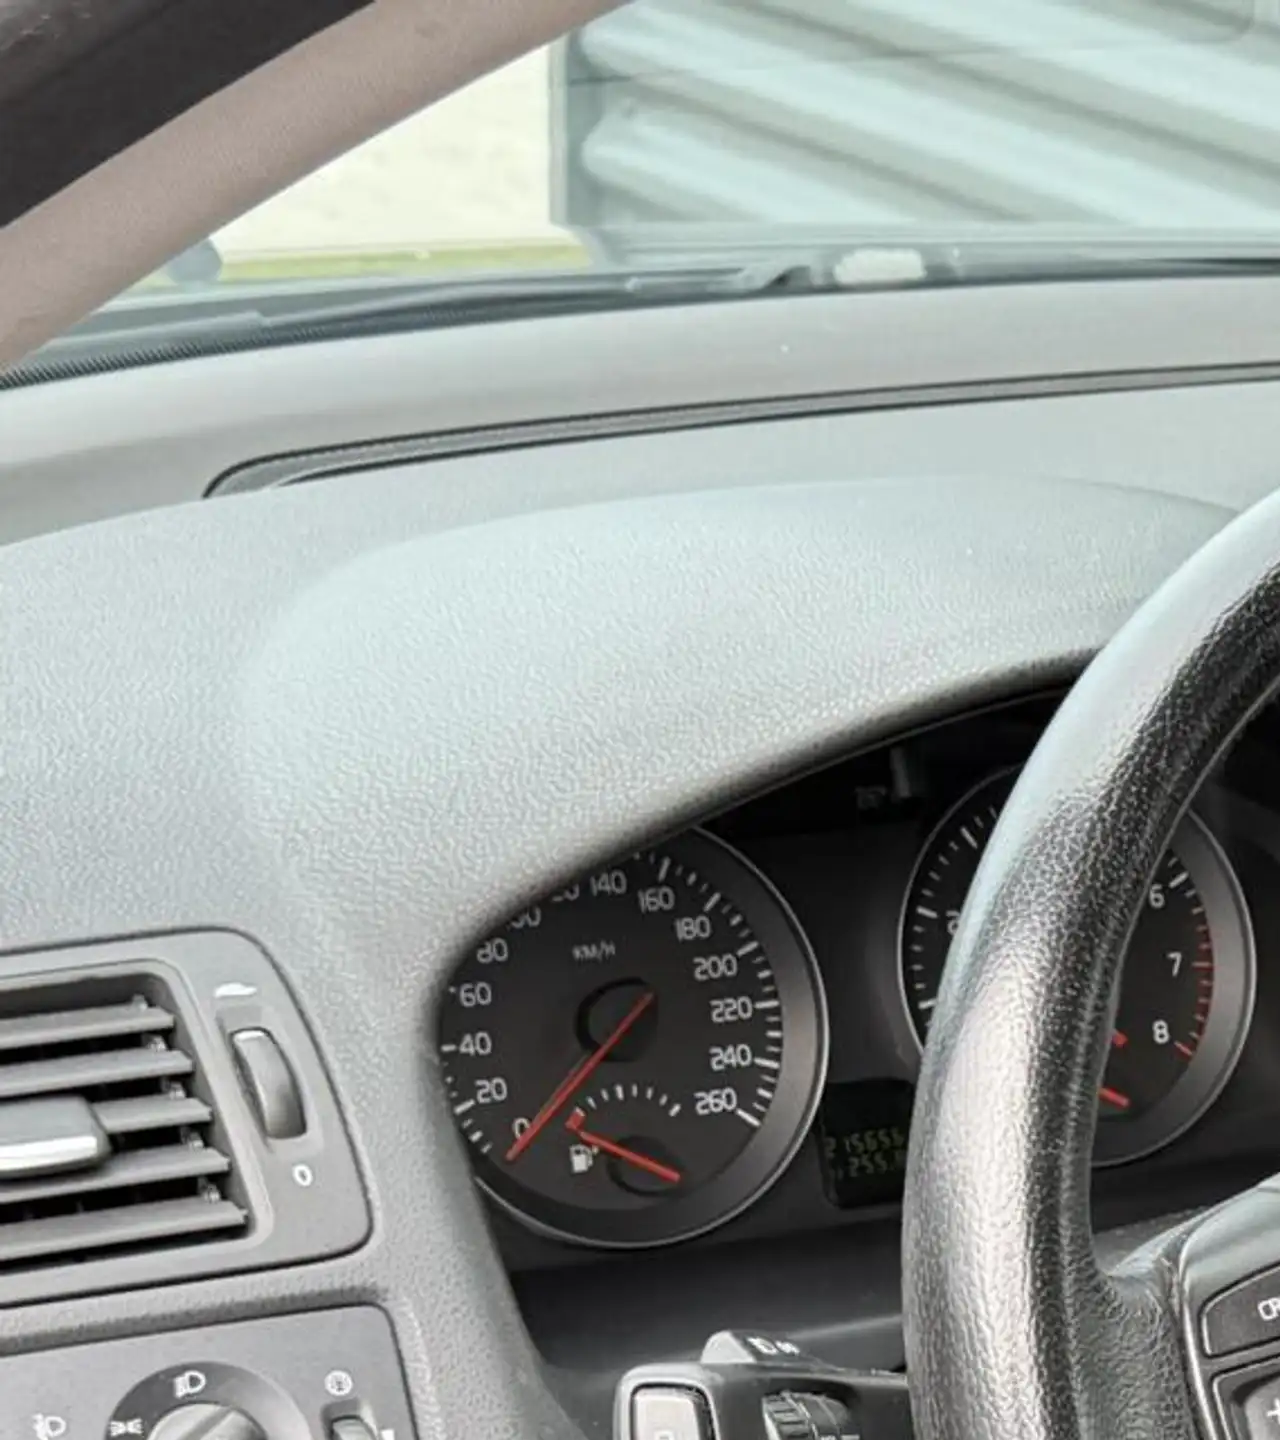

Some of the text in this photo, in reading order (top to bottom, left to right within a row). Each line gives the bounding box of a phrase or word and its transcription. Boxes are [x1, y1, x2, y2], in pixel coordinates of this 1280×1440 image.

[590, 871, 628, 896] 140
[638, 886, 675, 912] 160
[1149, 884, 1165, 909] 6
[675, 916, 711, 941] 180
[477, 938, 508, 963] 80
[693, 954, 738, 981] 200
[1167, 952, 1182, 977] 7
[460, 982, 492, 1008] 60
[710, 996, 753, 1023] 220
[459, 1032, 492, 1057] 40
[1152, 1020, 1169, 1045] 8
[709, 1044, 753, 1071] 240
[475, 1077, 507, 1103] 20
[693, 1088, 737, 1116] 260
